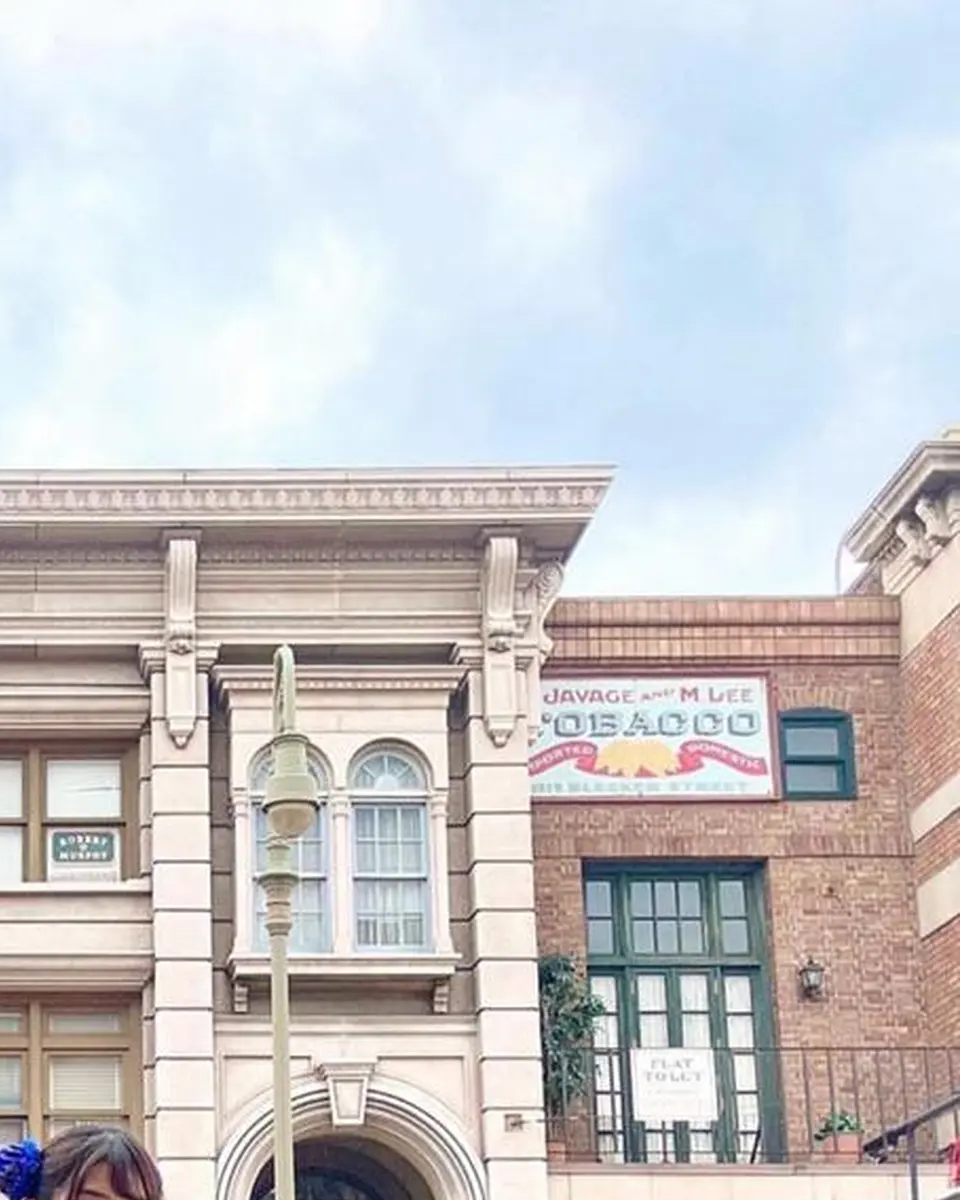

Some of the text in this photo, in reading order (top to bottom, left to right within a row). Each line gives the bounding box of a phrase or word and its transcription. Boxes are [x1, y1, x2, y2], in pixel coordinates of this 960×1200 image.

[543, 688, 635, 705] JAVAGE
[680, 687, 699, 702] M
[709, 687, 753, 703] LEE
